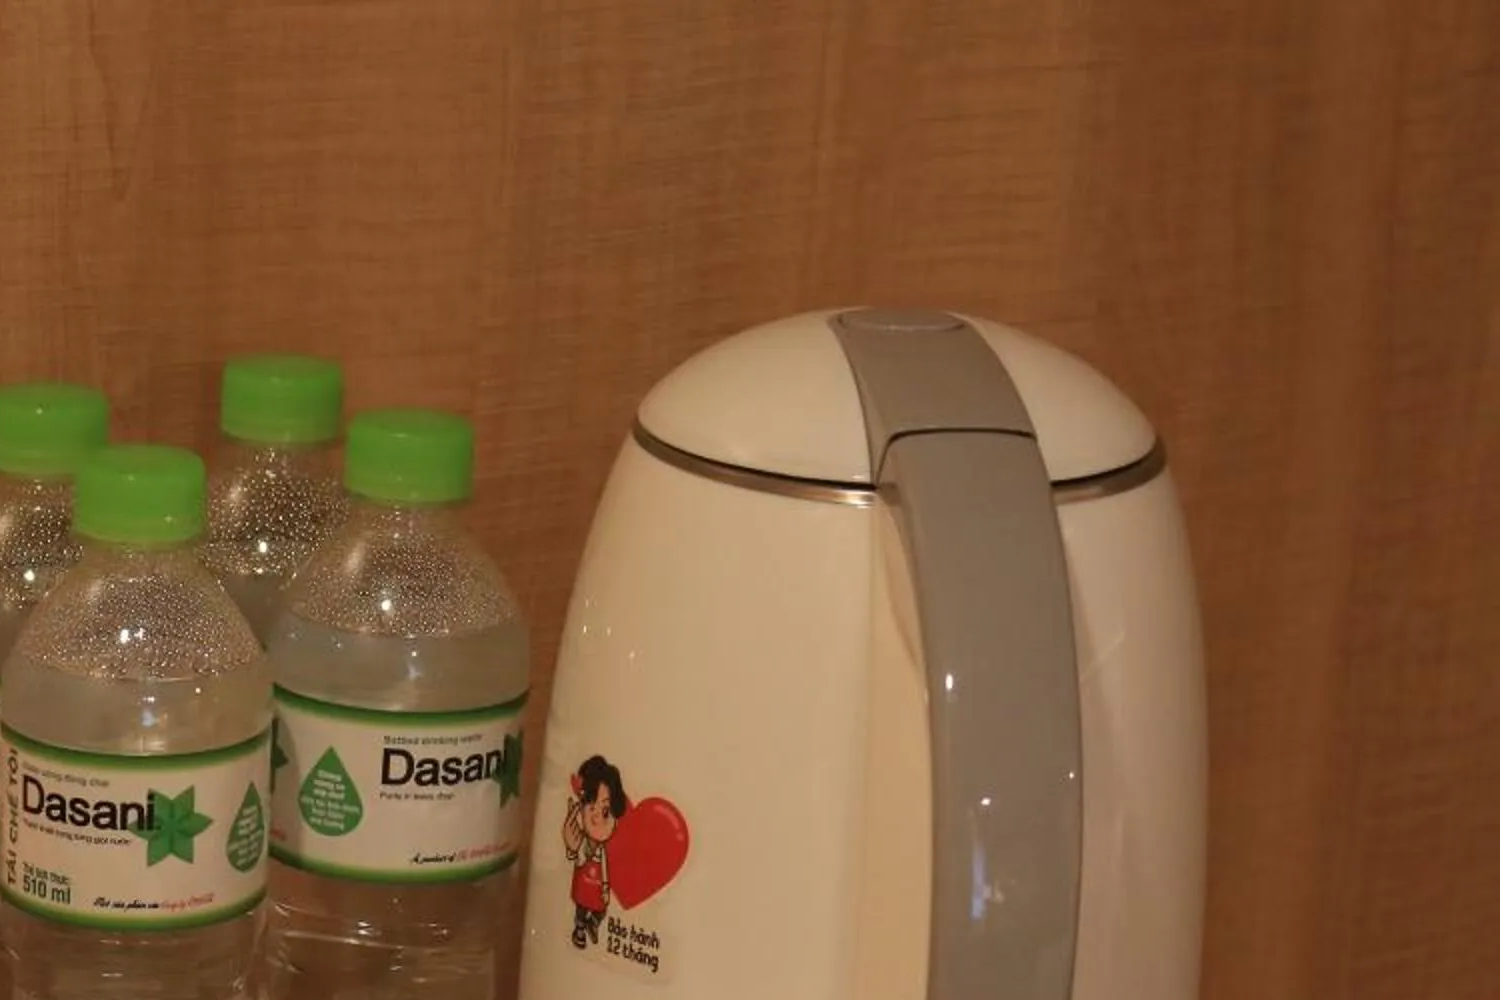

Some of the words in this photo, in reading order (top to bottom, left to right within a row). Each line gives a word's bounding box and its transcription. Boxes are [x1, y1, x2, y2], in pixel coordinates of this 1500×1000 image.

[21, 774, 156, 832] Dasani
[22, 874, 47, 899] 510
[50, 886, 71, 905] ml
